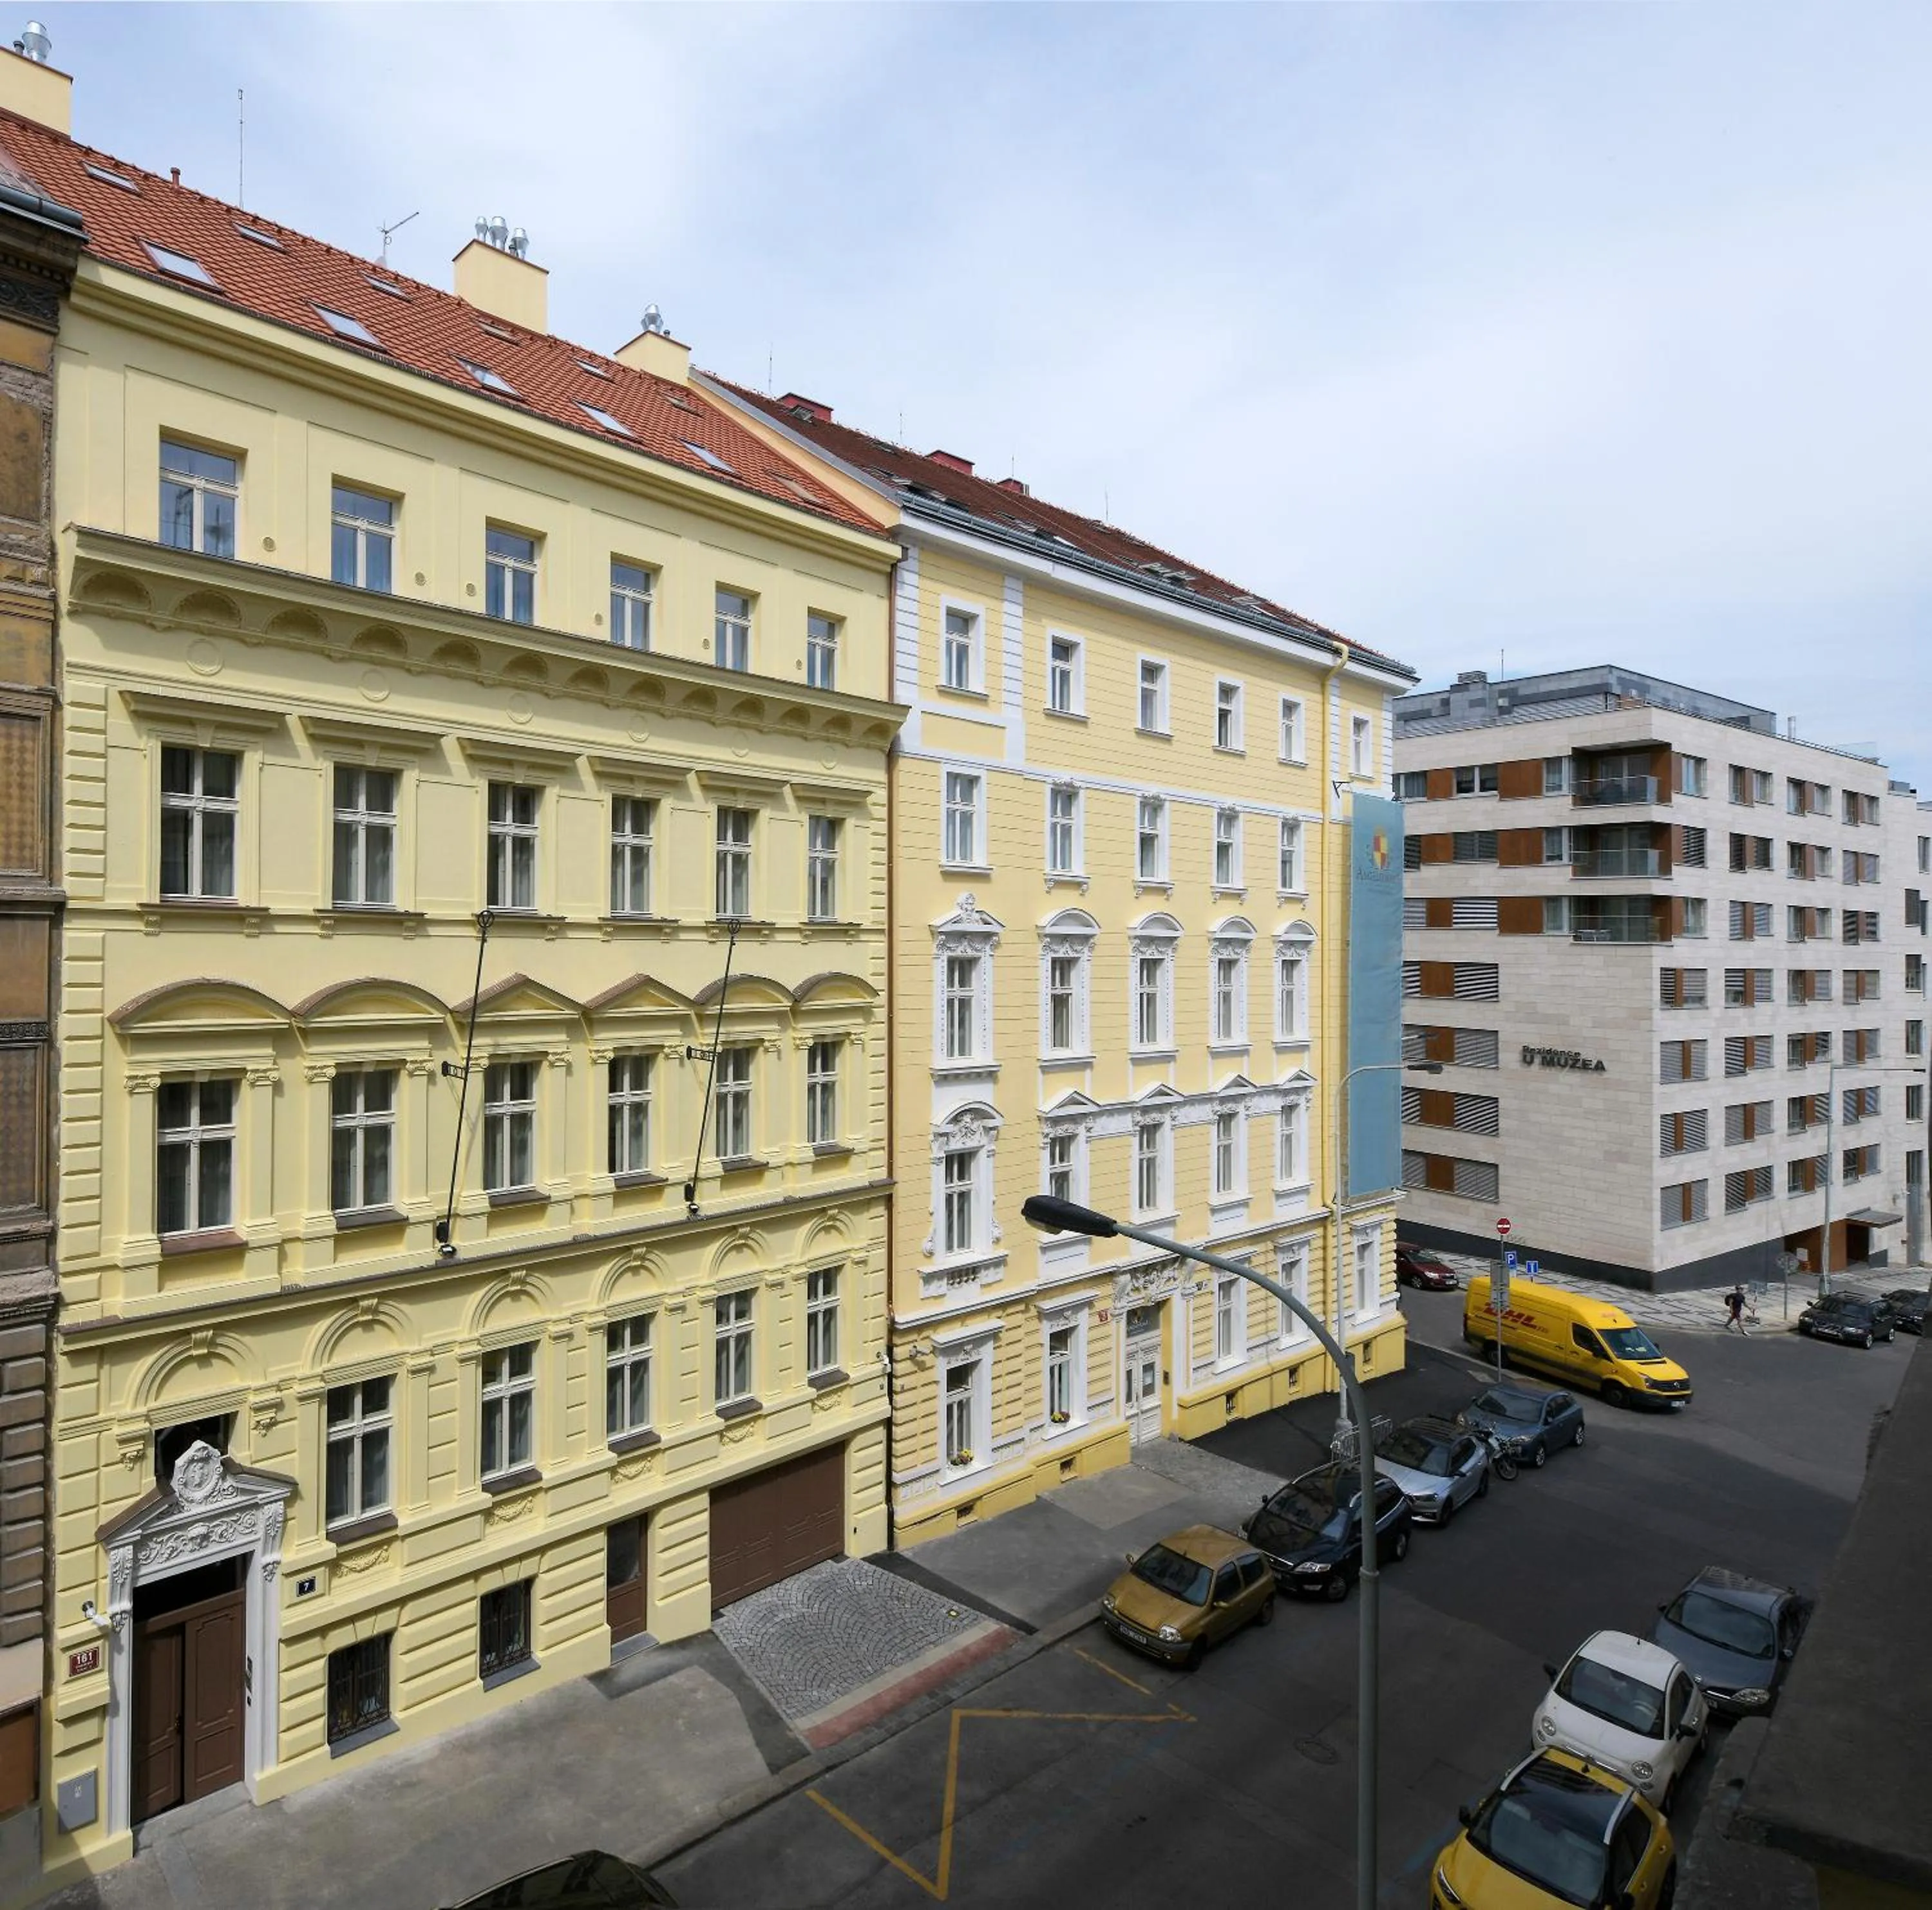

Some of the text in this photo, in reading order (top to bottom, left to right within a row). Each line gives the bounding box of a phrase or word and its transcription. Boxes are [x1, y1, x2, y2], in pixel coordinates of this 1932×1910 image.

[1522, 1045, 1581, 1057] Rezidence
[1522, 1054, 1606, 1072] U MUZEA
[1508, 1254, 1514, 1264] P
